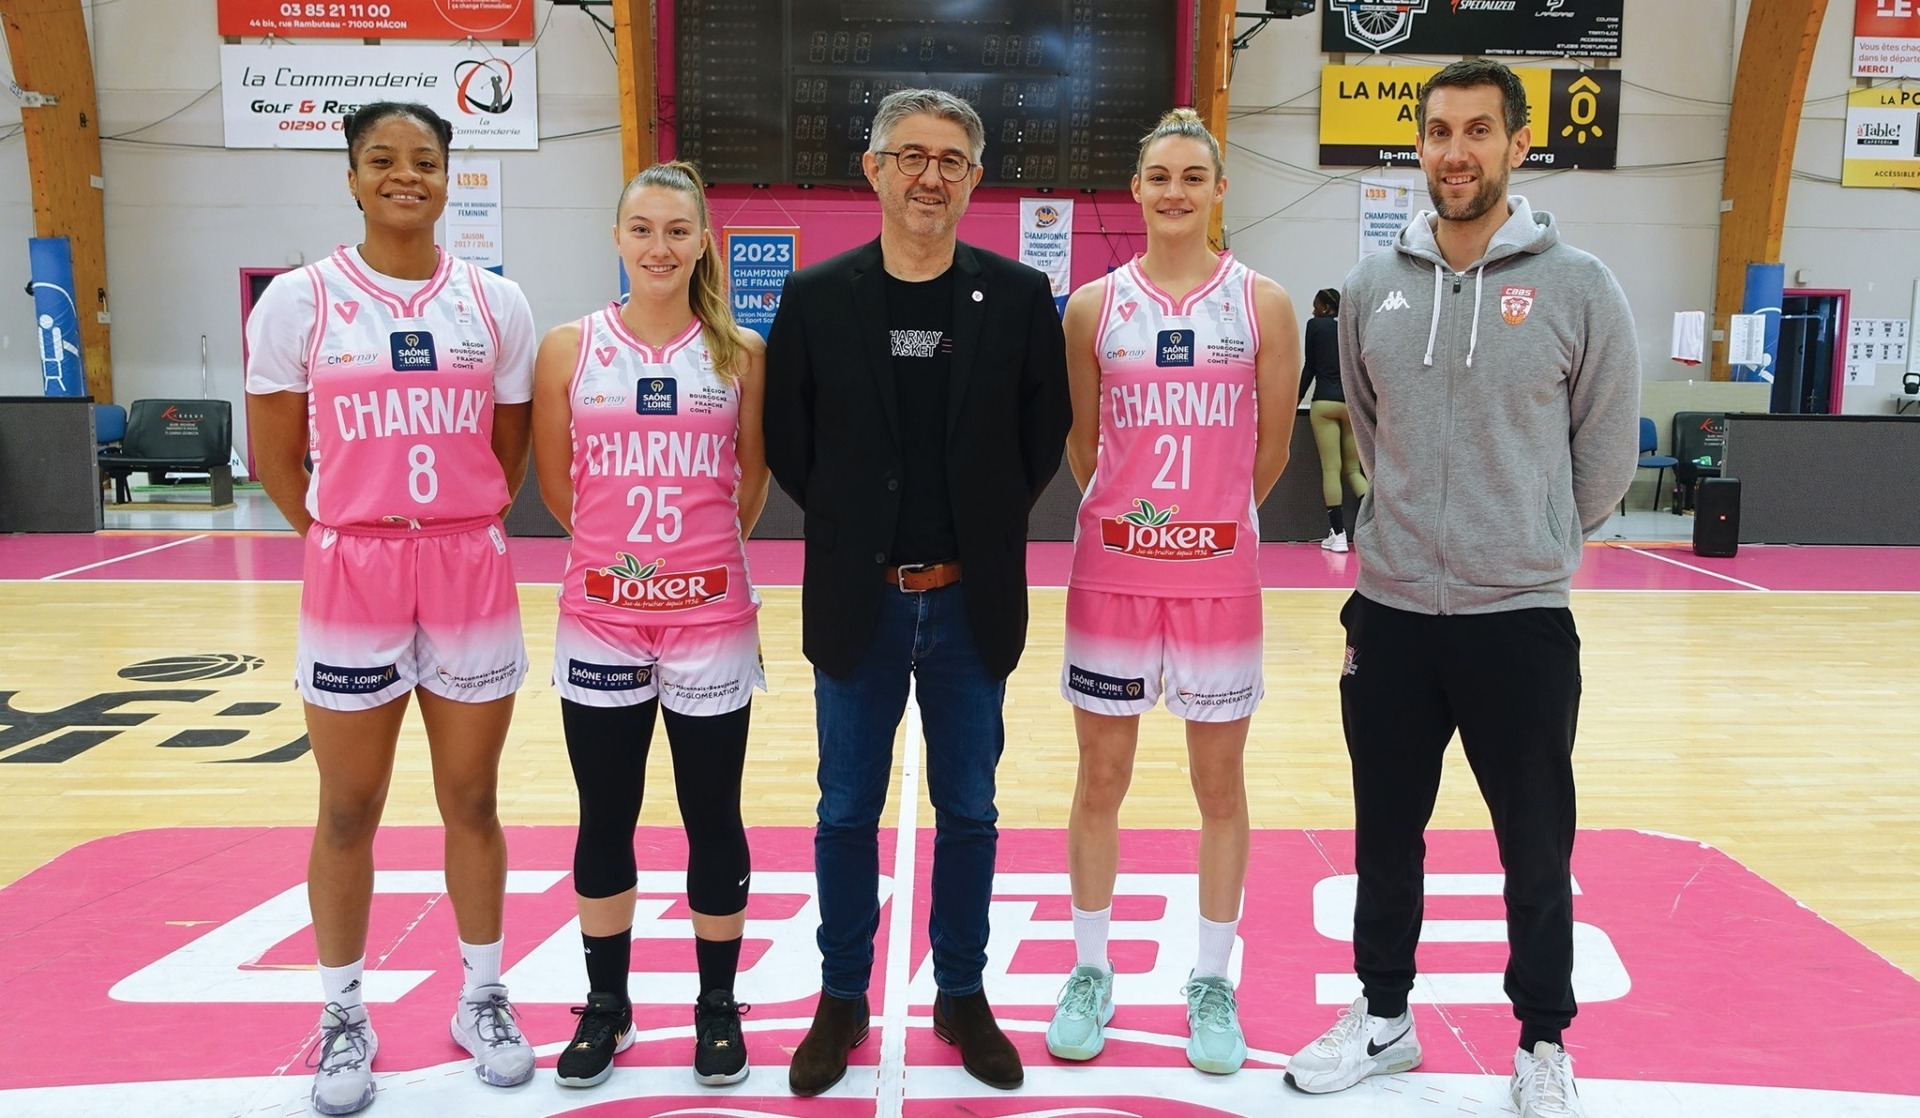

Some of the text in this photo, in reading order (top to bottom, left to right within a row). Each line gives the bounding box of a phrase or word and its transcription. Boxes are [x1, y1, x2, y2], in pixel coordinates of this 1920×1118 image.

[280, 3, 390, 18] 03 85 21 11 00
[1458, 0, 1514, 11] SPECIALIZED
[250, 19, 261, 27] 44
[262, 19, 277, 28] bis,
[294, 20, 340, 28] Rambuteau
[348, 20, 374, 29] 71000
[376, 19, 407, 29] MÂCON
[1860, 42, 1880, 50] Vous
[1881, 43, 1900, 51] êtes
[1858, 54, 1878, 62] dans
[1858, 64, 1888, 73] MERCI
[274, 68, 438, 88] Commanderie
[1339, 81, 1370, 100] LA
[1881, 94, 1896, 105] LA
[278, 120, 327, 131] 01290
[479, 117, 490, 126] la
[1364, 212, 1408, 220] CHAMPIONNE
[1024, 232, 1068, 240] CHAMPIONNE
[734, 244, 790, 262] 2023
[734, 270, 790, 278] CHAMPIONS
[890, 330, 943, 344] HARNAY
[398, 348, 430, 357] SAÔNE
[890, 342, 936, 357] ASKET
[1162, 344, 1189, 354] SAÔNE
[1207, 344, 1244, 352] BOURGOGNE
[643, 393, 672, 401] SAÔNE
[690, 393, 727, 402] BOURGOGNE
[1110, 382, 1244, 429] CHARNAY
[334, 388, 488, 442] CHARNAY
[586, 431, 727, 478] CHARNAY
[1152, 434, 1192, 490] 21
[408, 444, 438, 504] 8
[626, 485, 683, 543] 25
[316, 671, 348, 684] SAÔNE
[571, 666, 601, 680] SAÔNE
[607, 671, 633, 681] LOIRE
[1071, 672, 1095, 687] SAÔNE
[1099, 681, 1123, 692] LOIRE
